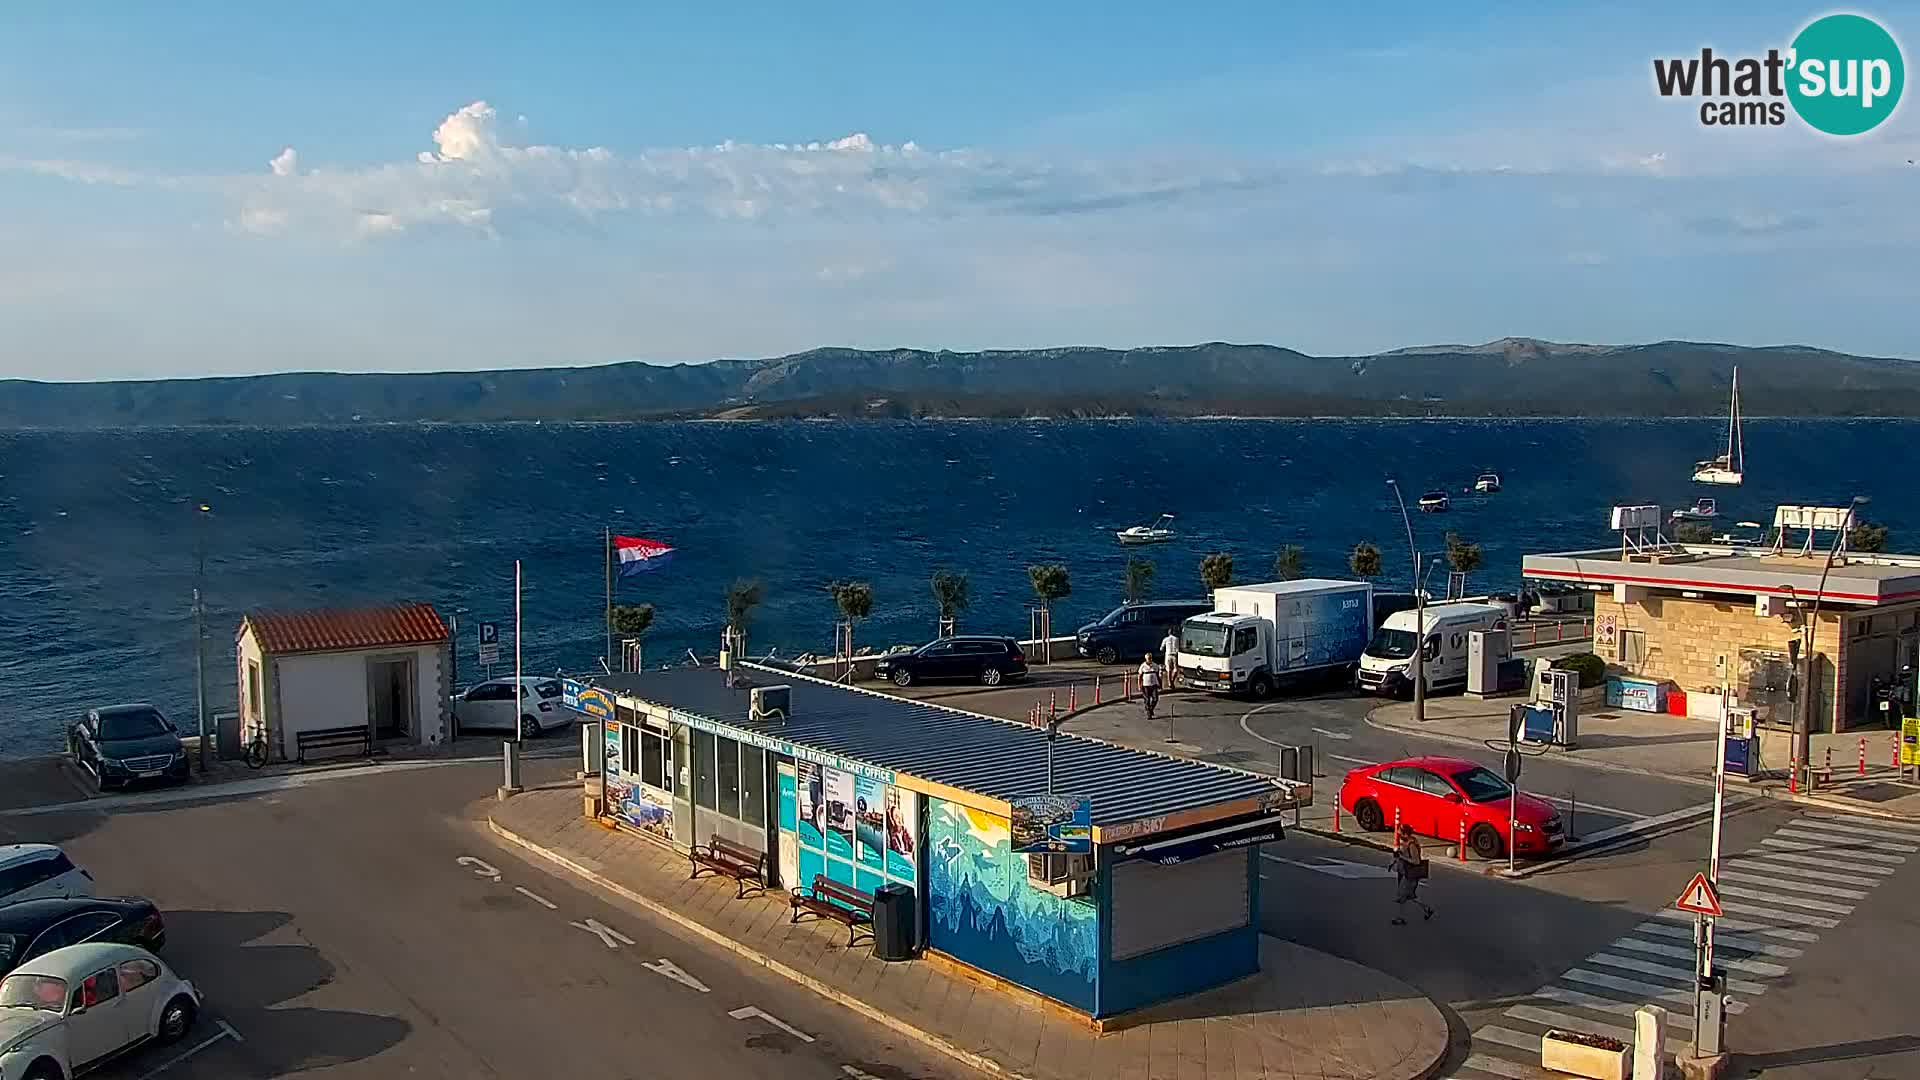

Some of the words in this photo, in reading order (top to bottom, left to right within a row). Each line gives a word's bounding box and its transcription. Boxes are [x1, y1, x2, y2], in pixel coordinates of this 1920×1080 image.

[483, 624, 495, 641] P
[716, 724, 753, 744] AUTOBUSNA
[754, 736, 782, 752] POSTAJA
[793, 746, 806, 760] BUS
[808, 751, 838, 768] STATION
[840, 760, 864, 774] TICKET
[865, 767, 891, 781] OFFICE
